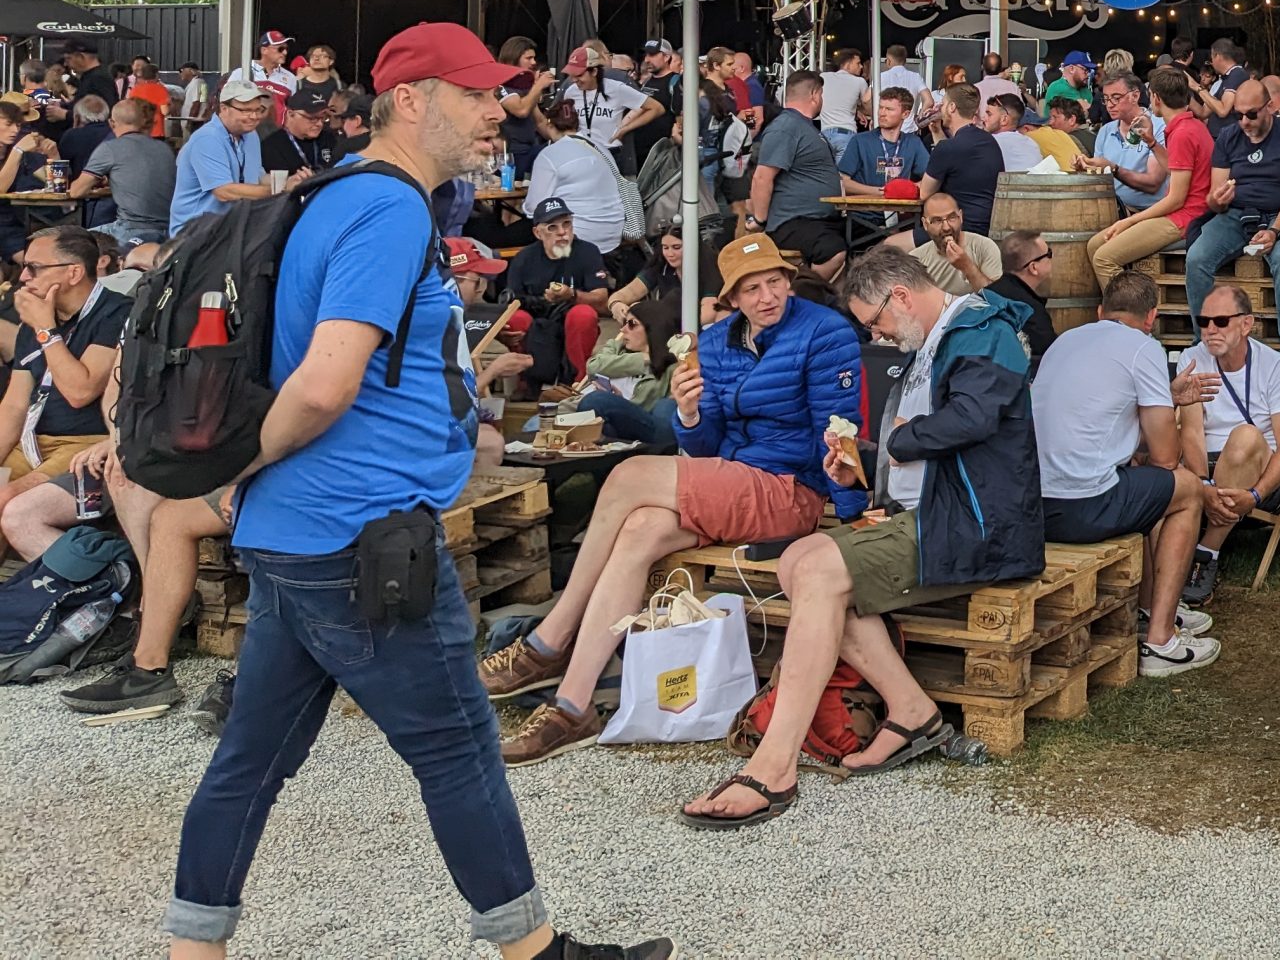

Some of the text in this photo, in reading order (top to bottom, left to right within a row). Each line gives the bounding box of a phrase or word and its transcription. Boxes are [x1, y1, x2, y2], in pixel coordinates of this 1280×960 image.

[37, 21, 115, 33] Carlsberg
[596, 106, 613, 118] DAY
[665, 672, 689, 687] Hertz
